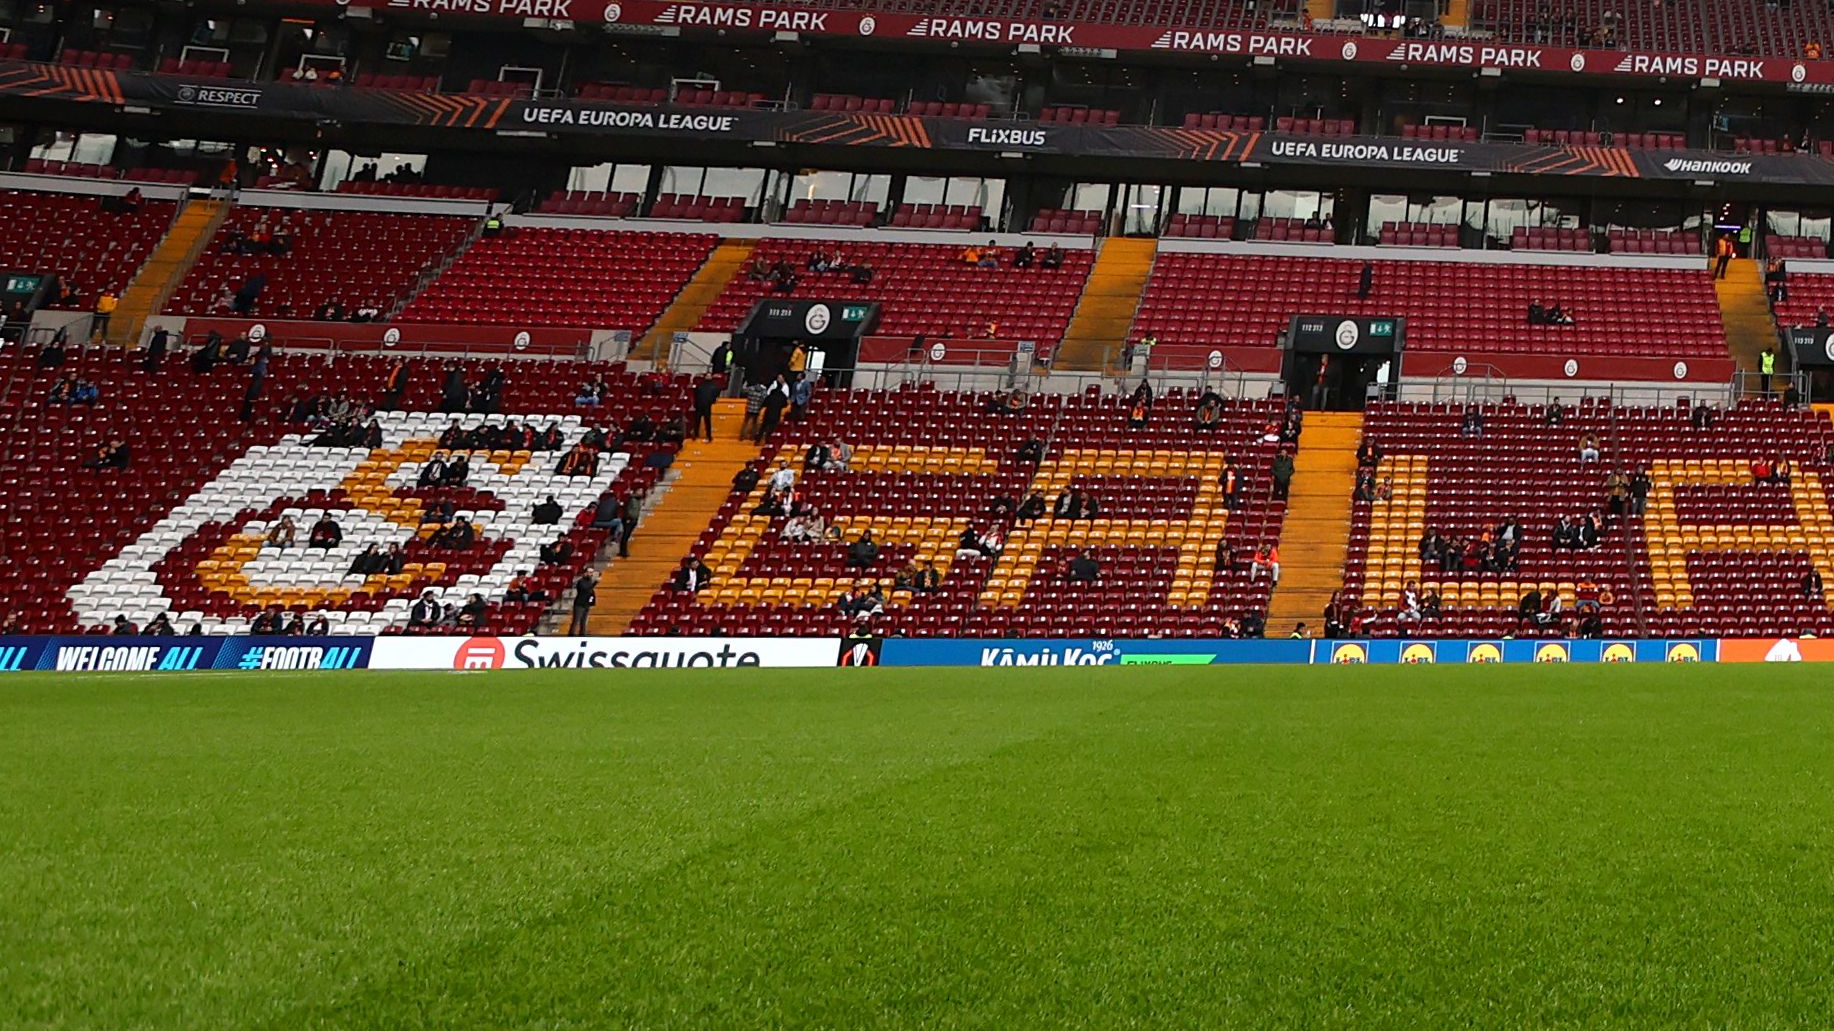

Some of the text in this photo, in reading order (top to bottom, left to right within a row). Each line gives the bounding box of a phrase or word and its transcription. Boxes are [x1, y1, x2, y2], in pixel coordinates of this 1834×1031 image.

[677, 4, 829, 32] RAMS PARK
[929, 19, 1075, 44] RAMS PARK
[1173, 31, 1314, 56] RAMS PARK
[1407, 43, 1542, 67] RAMS PARK
[1634, 55, 1765, 79] RAMS PARK
[198, 87, 262, 106] RESPECT
[523, 107, 733, 131] UEFA EUROPA LEAGUE
[1271, 141, 1459, 163] UEFA EUROPA LEAGUE
[1093, 639, 1113, 651] 1926
[56, 646, 203, 671] WELCOME ALL
